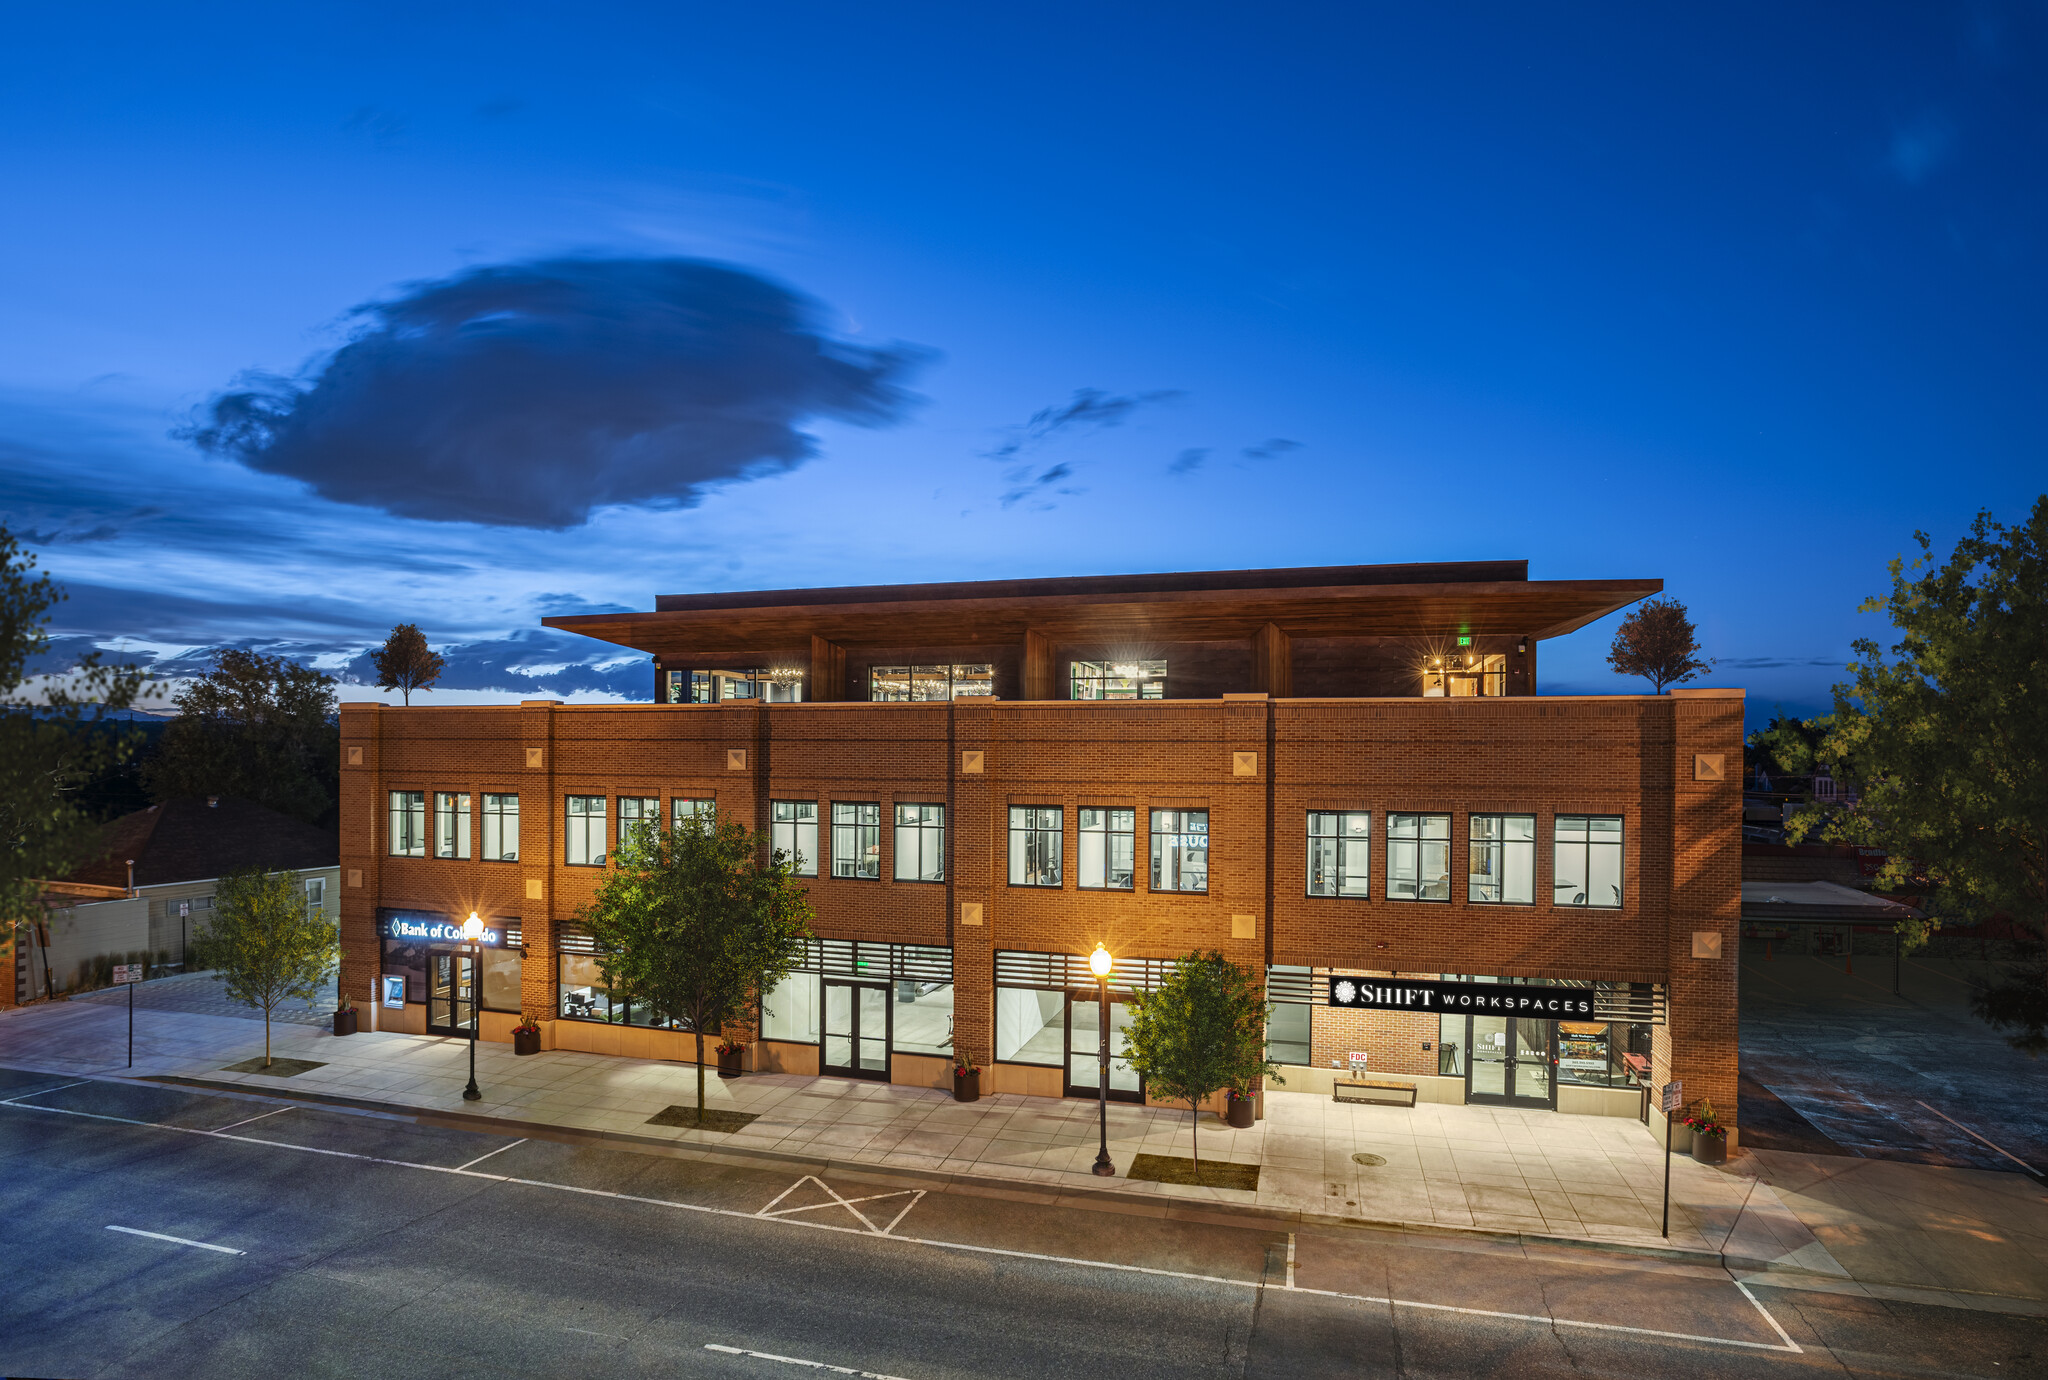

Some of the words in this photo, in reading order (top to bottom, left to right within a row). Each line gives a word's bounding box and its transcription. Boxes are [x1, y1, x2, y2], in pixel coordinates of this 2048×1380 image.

[401, 922, 428, 937] Bank
[430, 924, 444, 937] of
[444, 926, 496, 942] Coldo
[1360, 984, 1435, 1006] SHIFT
[1443, 994, 1589, 1012] WORKSPACES
[1350, 1053, 1366, 1061] FDC
